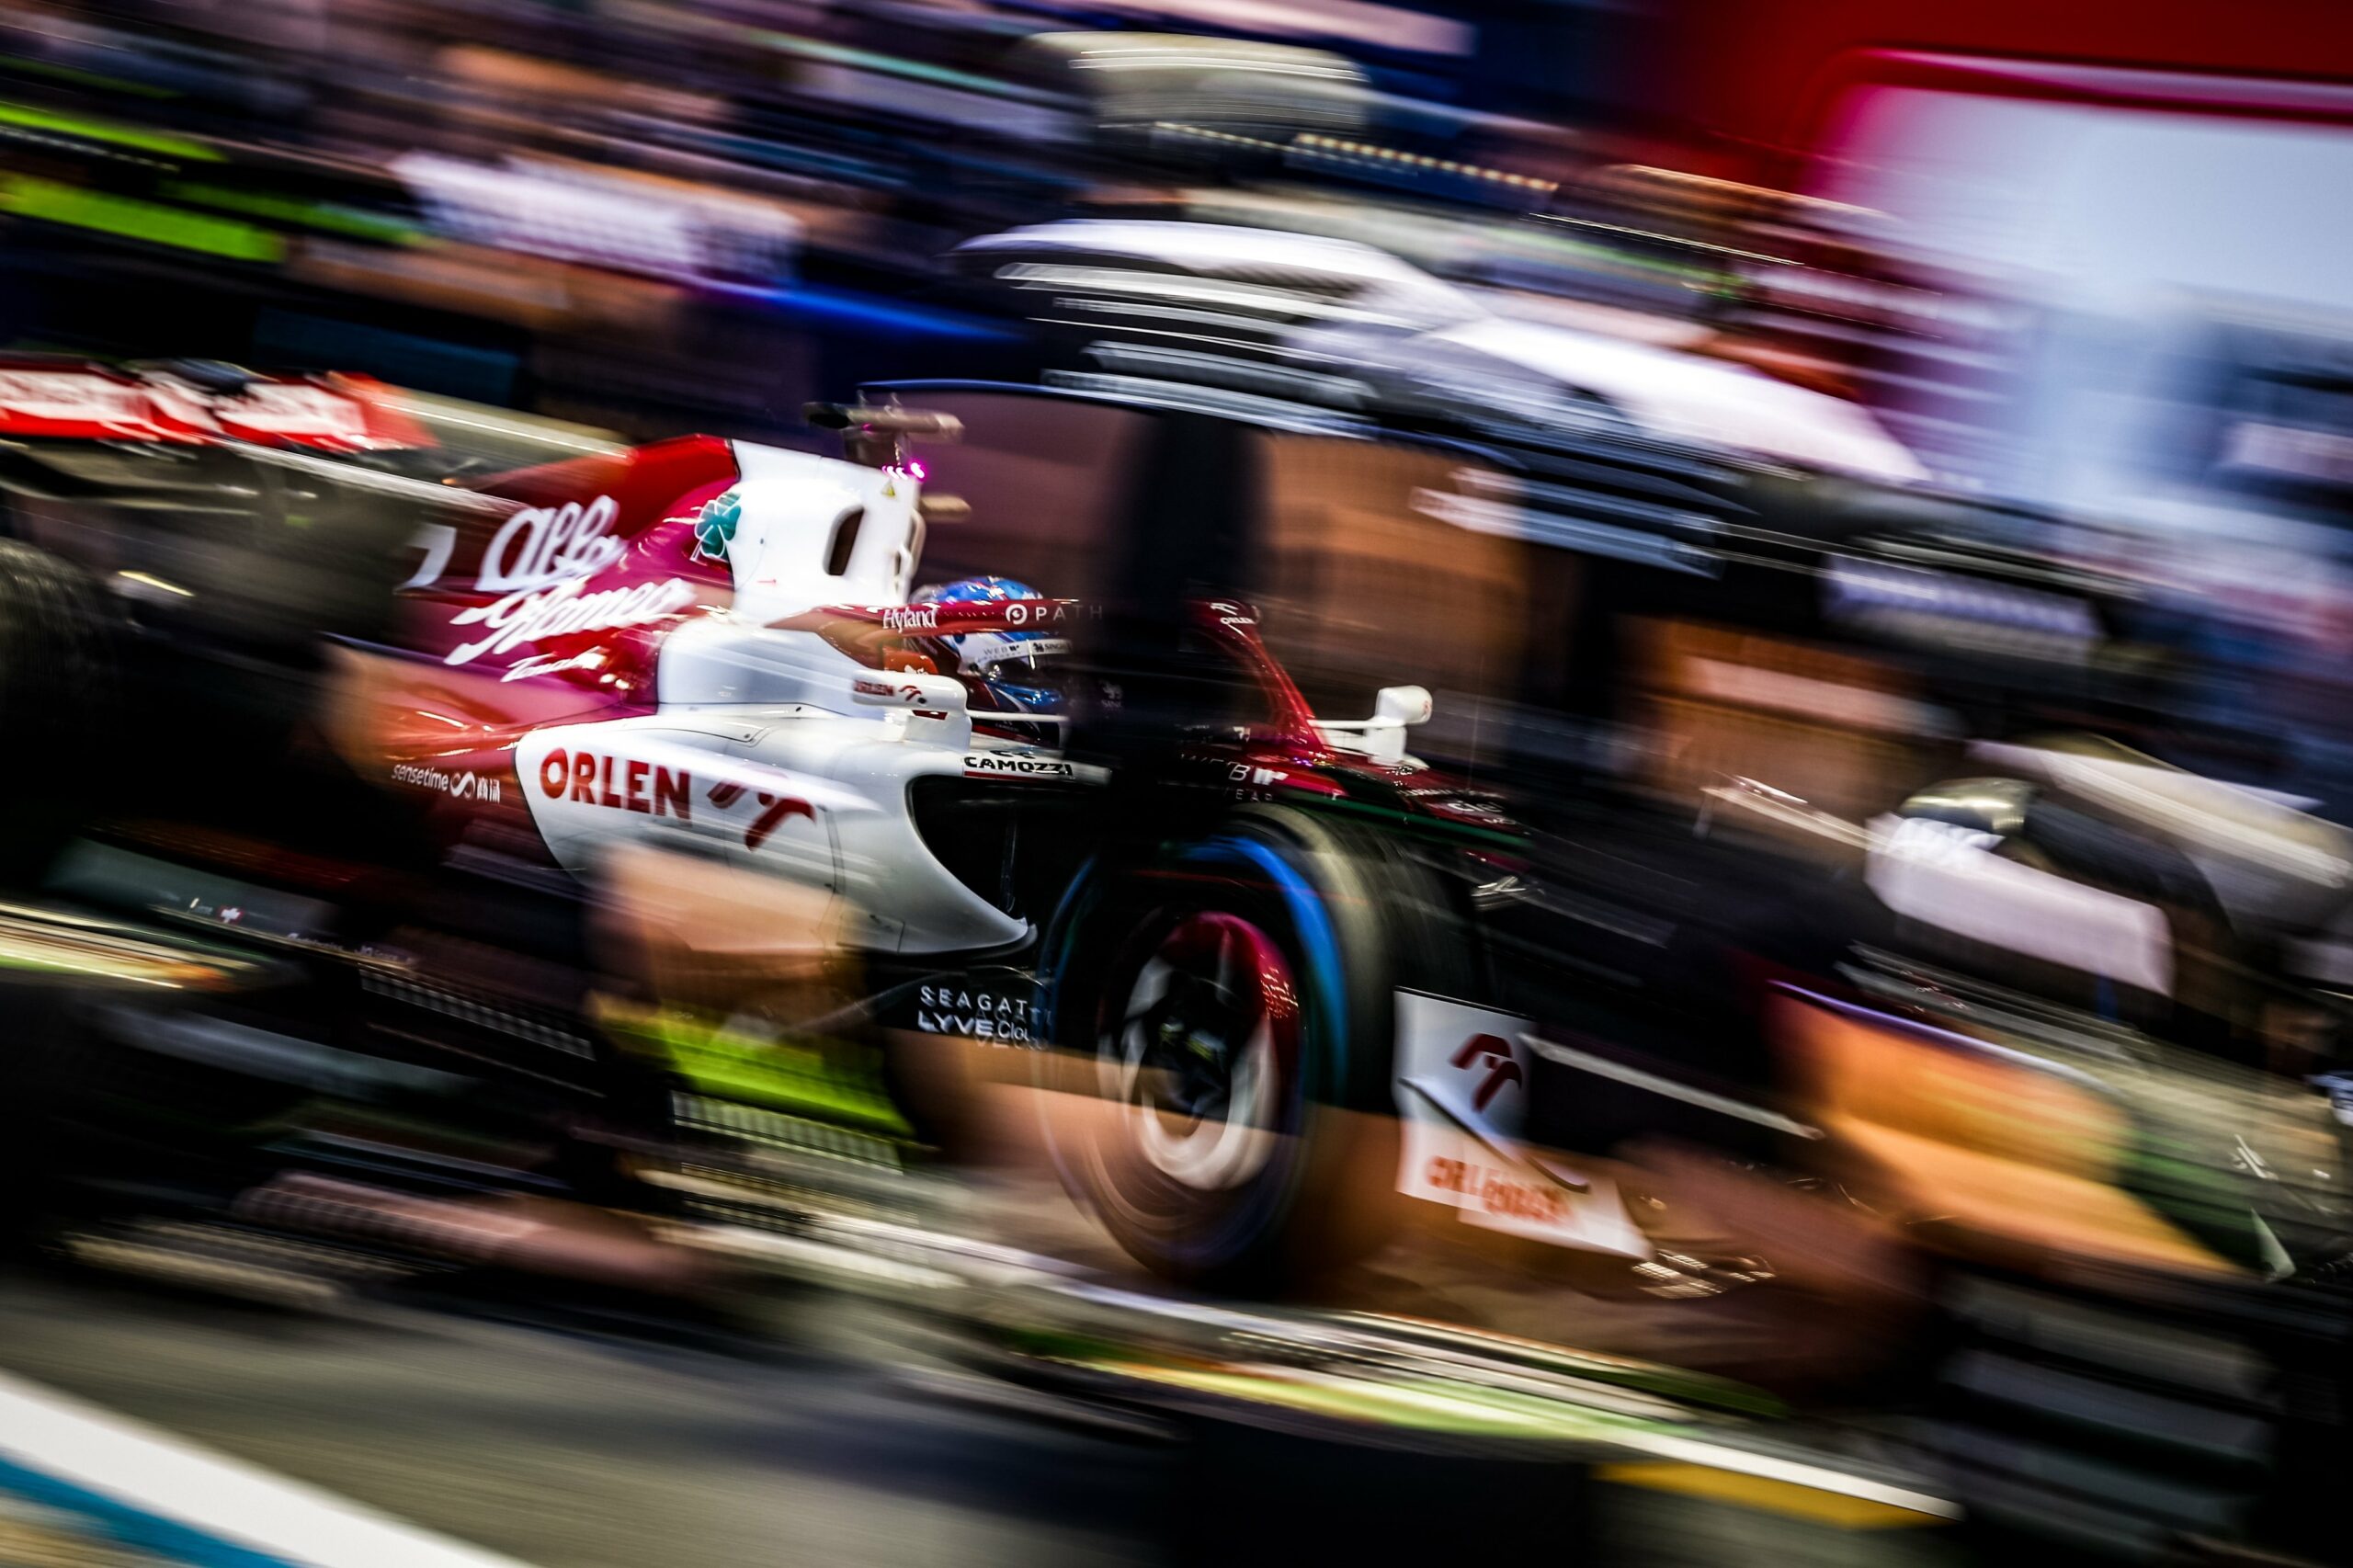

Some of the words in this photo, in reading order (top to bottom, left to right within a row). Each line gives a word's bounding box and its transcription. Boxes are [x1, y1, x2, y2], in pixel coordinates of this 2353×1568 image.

[474, 495, 626, 591] Alfa
[882, 606, 938, 634] Hyland
[391, 764, 449, 792] sensetime
[964, 756, 1074, 776] CAMOZZI
[540, 747, 692, 824] ORLEN
